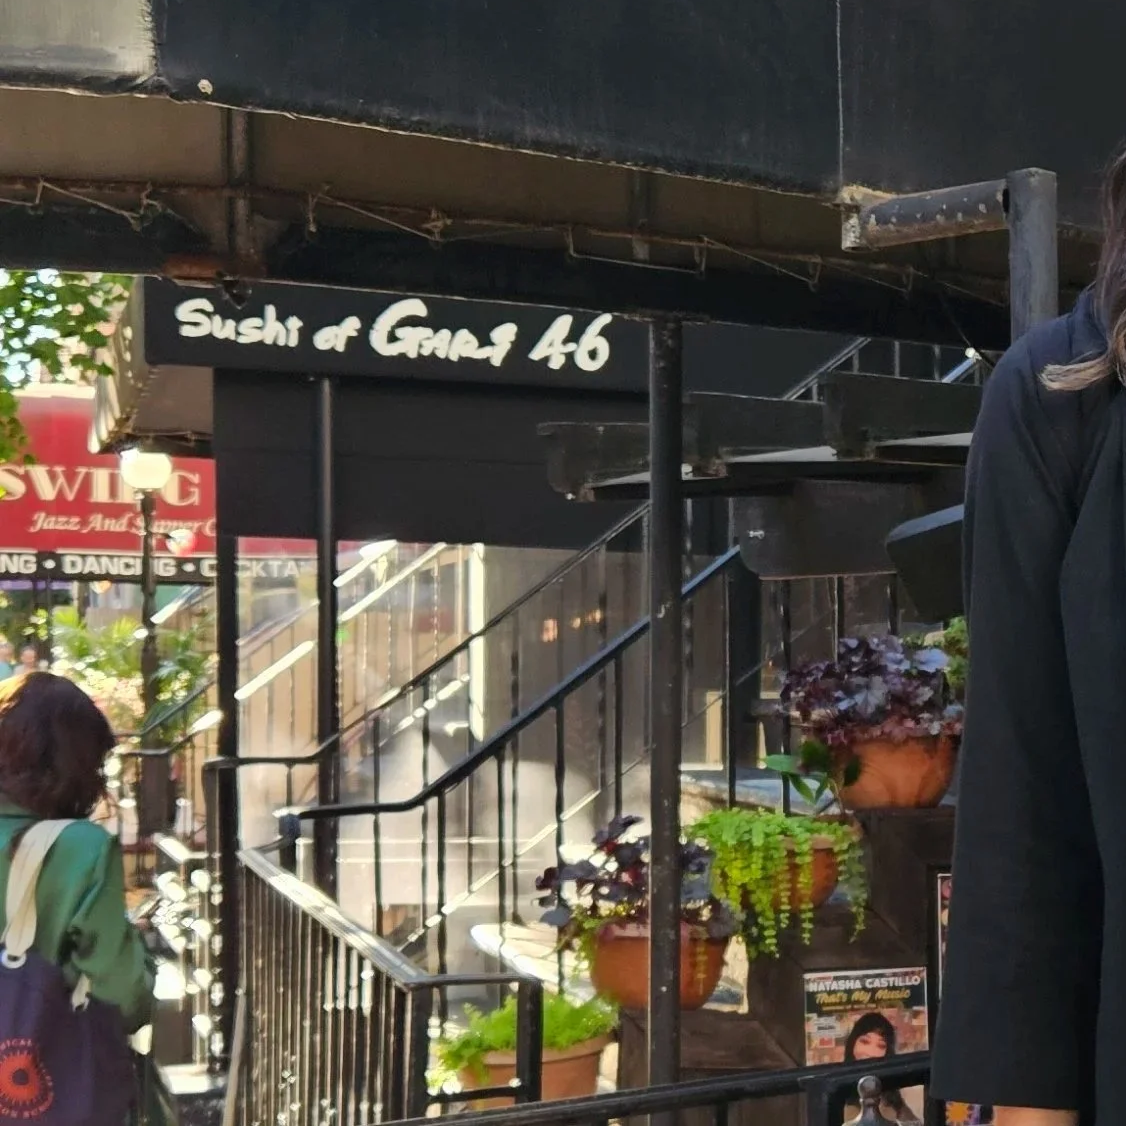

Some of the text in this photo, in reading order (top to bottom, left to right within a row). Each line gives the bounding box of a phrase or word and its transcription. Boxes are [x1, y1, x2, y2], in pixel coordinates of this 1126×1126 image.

[175, 298, 303, 347] Sushi
[313, 316, 361, 352] of
[528, 312, 613, 372] 46
[0, 464, 201, 506] SWIG
[28, 511, 80, 533] Jazz
[81, 512, 133, 534] And
[808, 975, 921, 992] NATASHA CASTILLO
[875, 987, 911, 1001] Music
